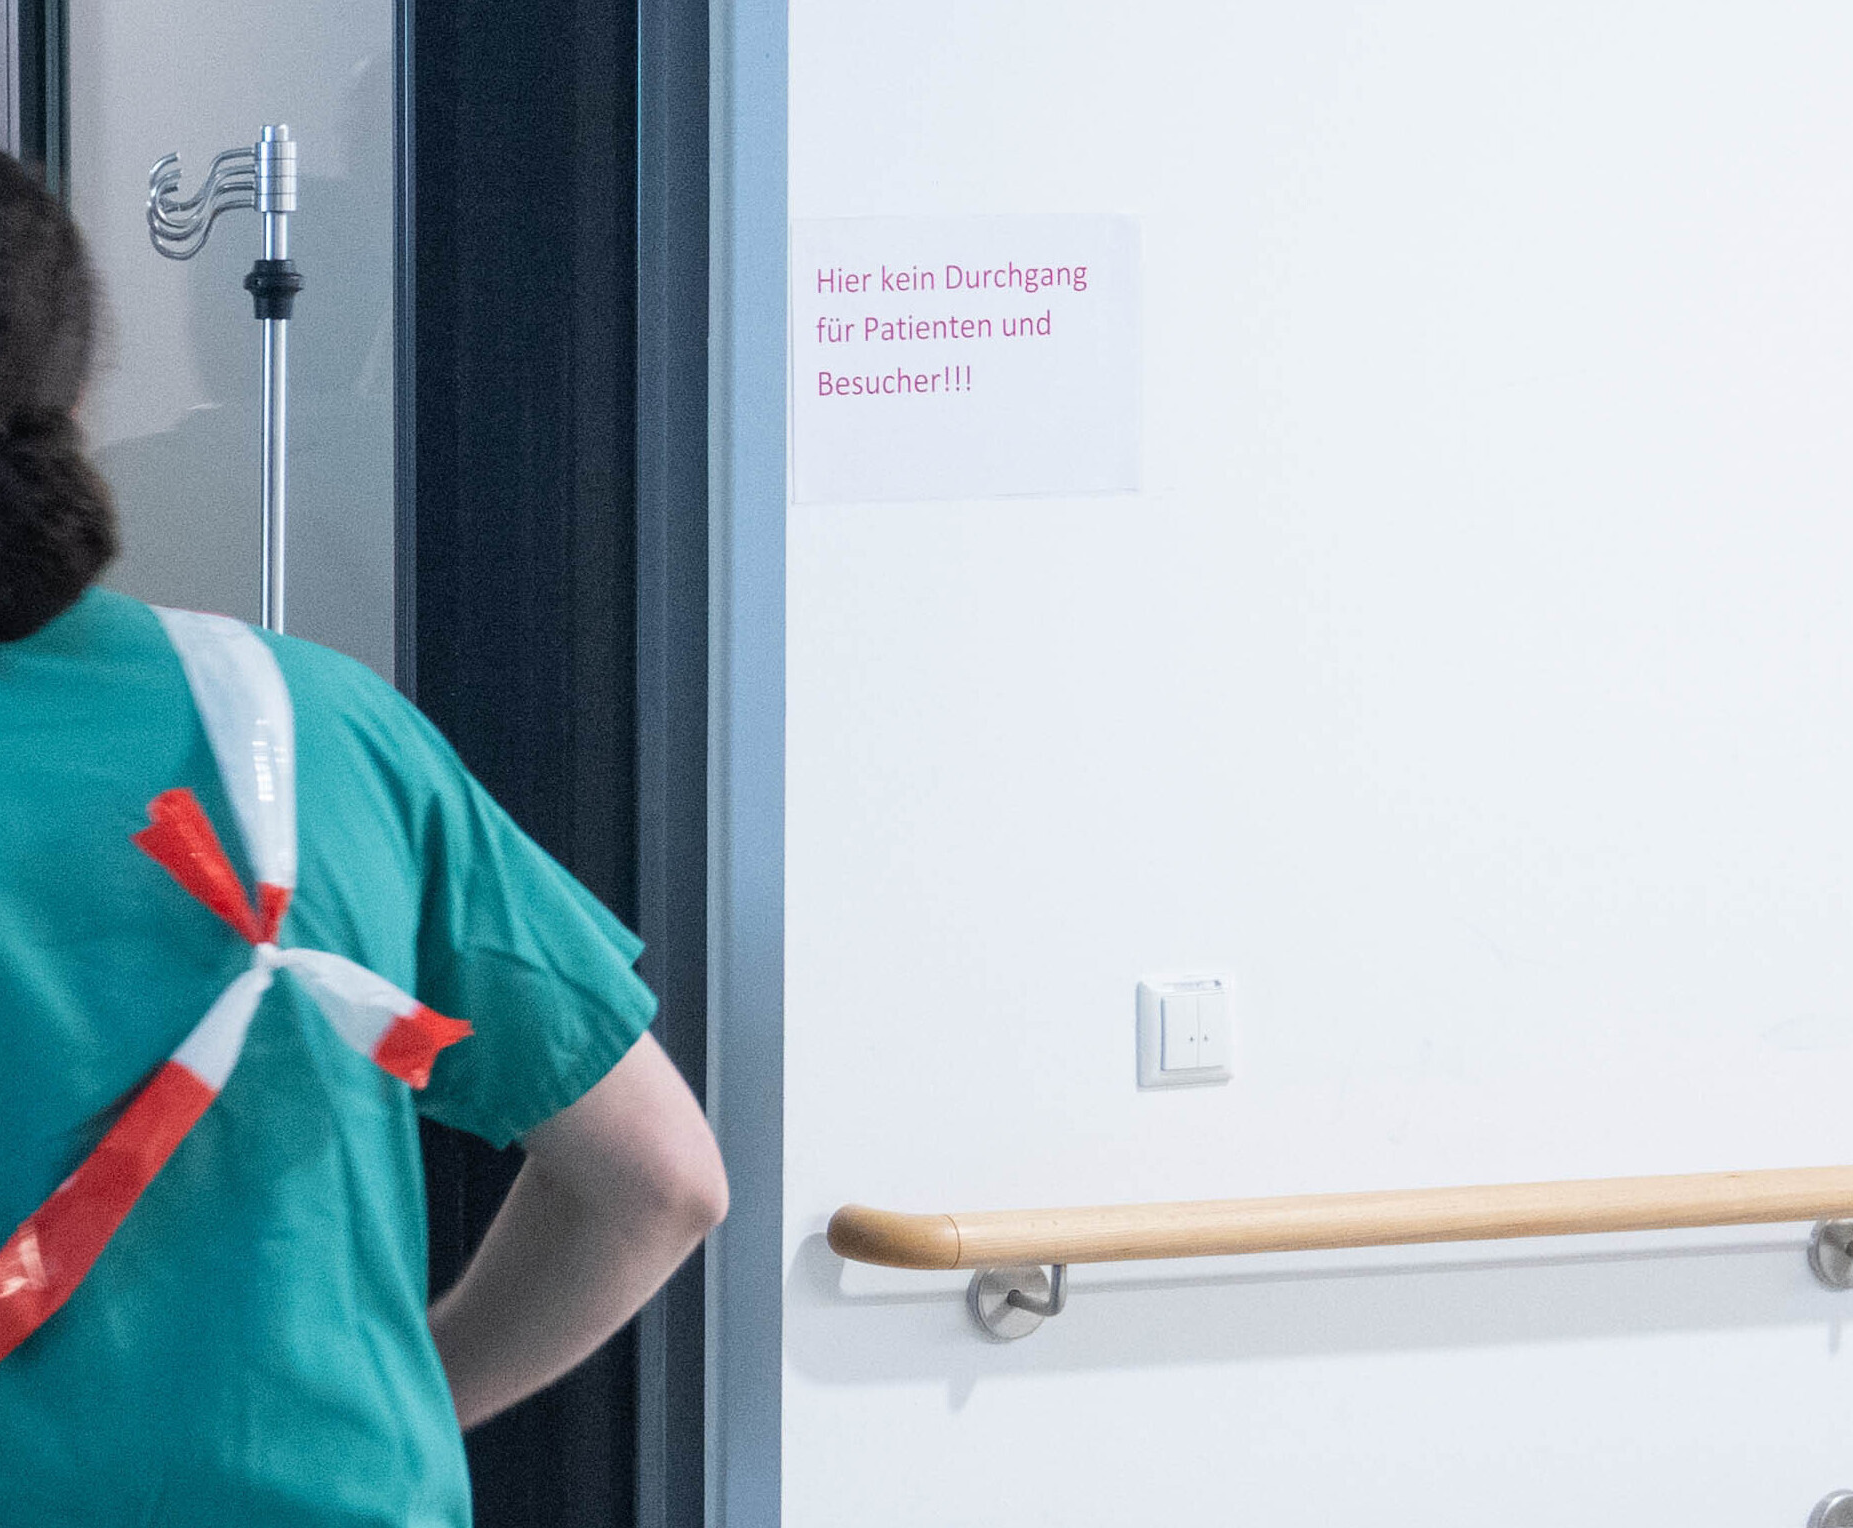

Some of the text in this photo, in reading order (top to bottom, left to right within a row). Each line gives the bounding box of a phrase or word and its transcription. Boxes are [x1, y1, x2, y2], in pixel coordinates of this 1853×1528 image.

[817, 261, 1088, 293] Hier kein Durchgang
[816, 309, 1051, 343] für Patienten und
[818, 365, 972, 397] Besucher!!!
